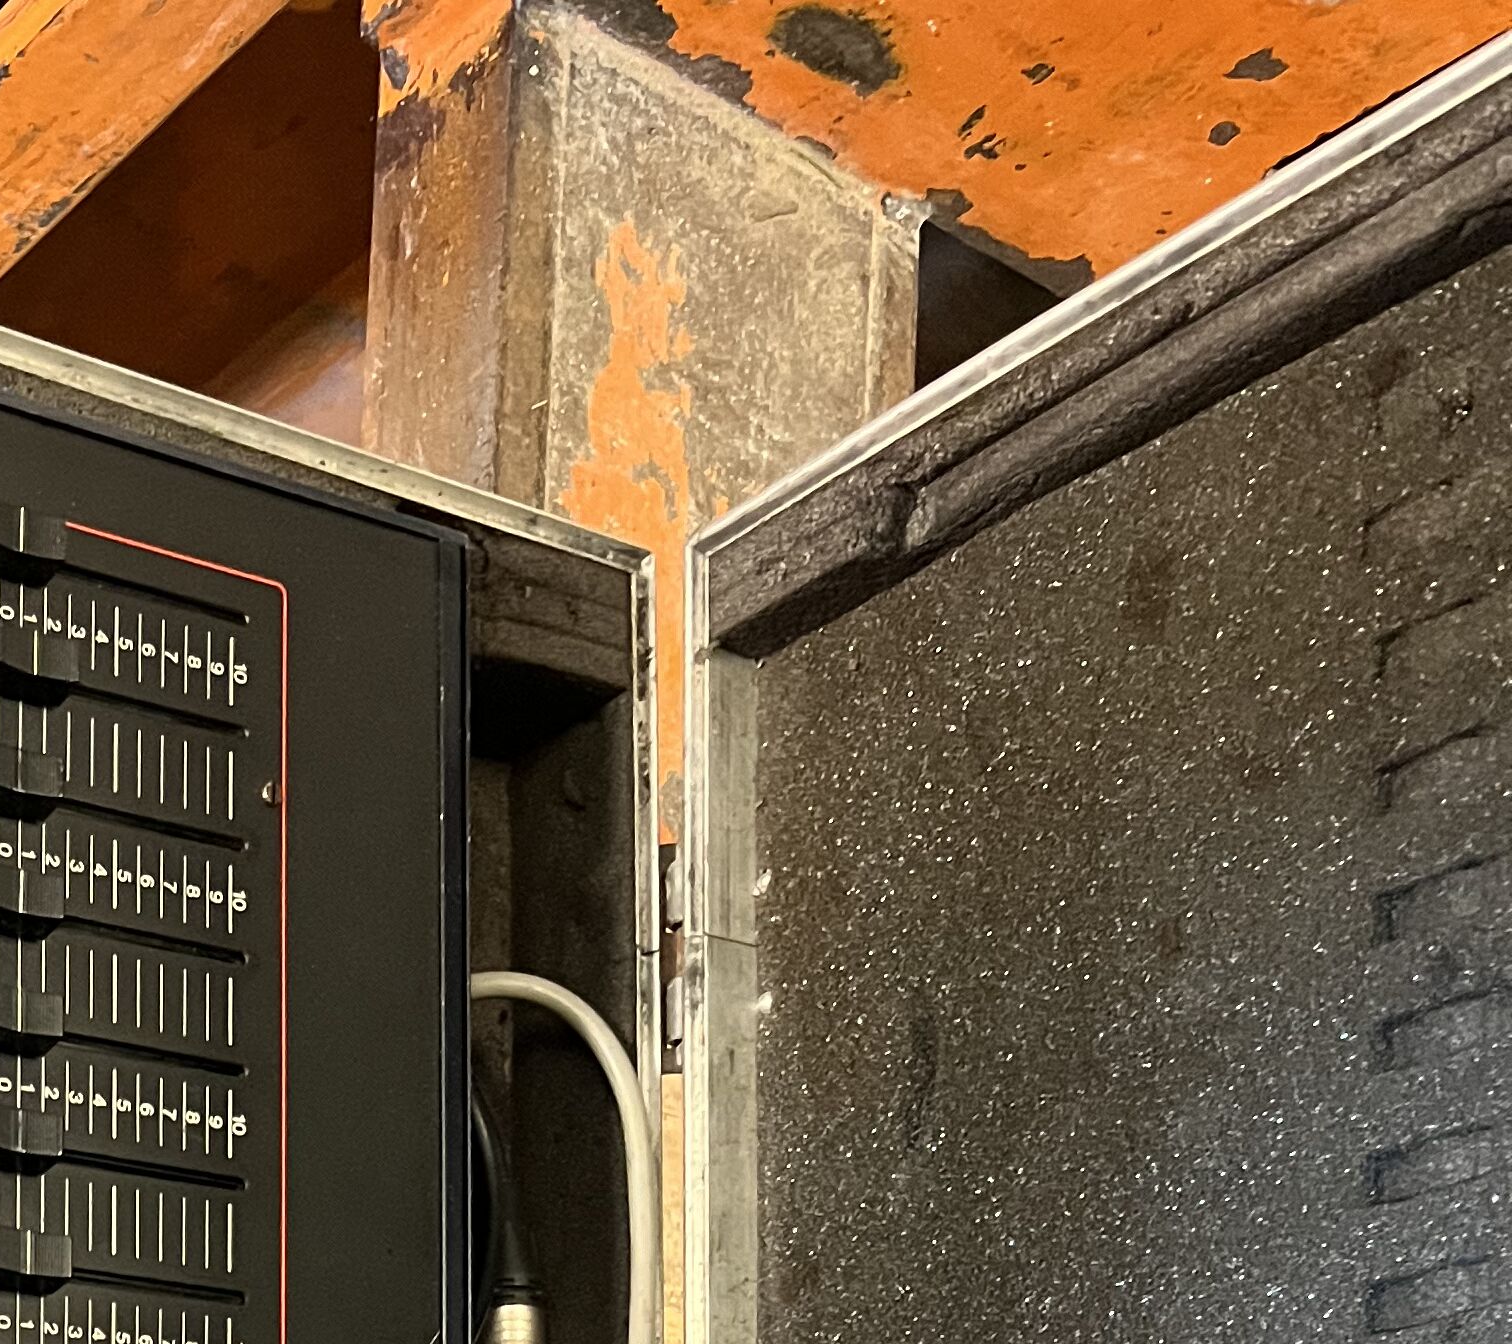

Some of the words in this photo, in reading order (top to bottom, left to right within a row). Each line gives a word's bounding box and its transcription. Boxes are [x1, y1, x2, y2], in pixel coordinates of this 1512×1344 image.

[45, 852, 61, 868] 2
[68, 858, 85, 874] 3
[93, 862, 108, 877] 4
[116, 868, 133, 884] 5
[139, 873, 156, 889] 6
[162, 881, 178, 895] 7
[185, 884, 202, 899] 8
[208, 890, 224, 904] 9
[231, 889, 248, 912] 10
